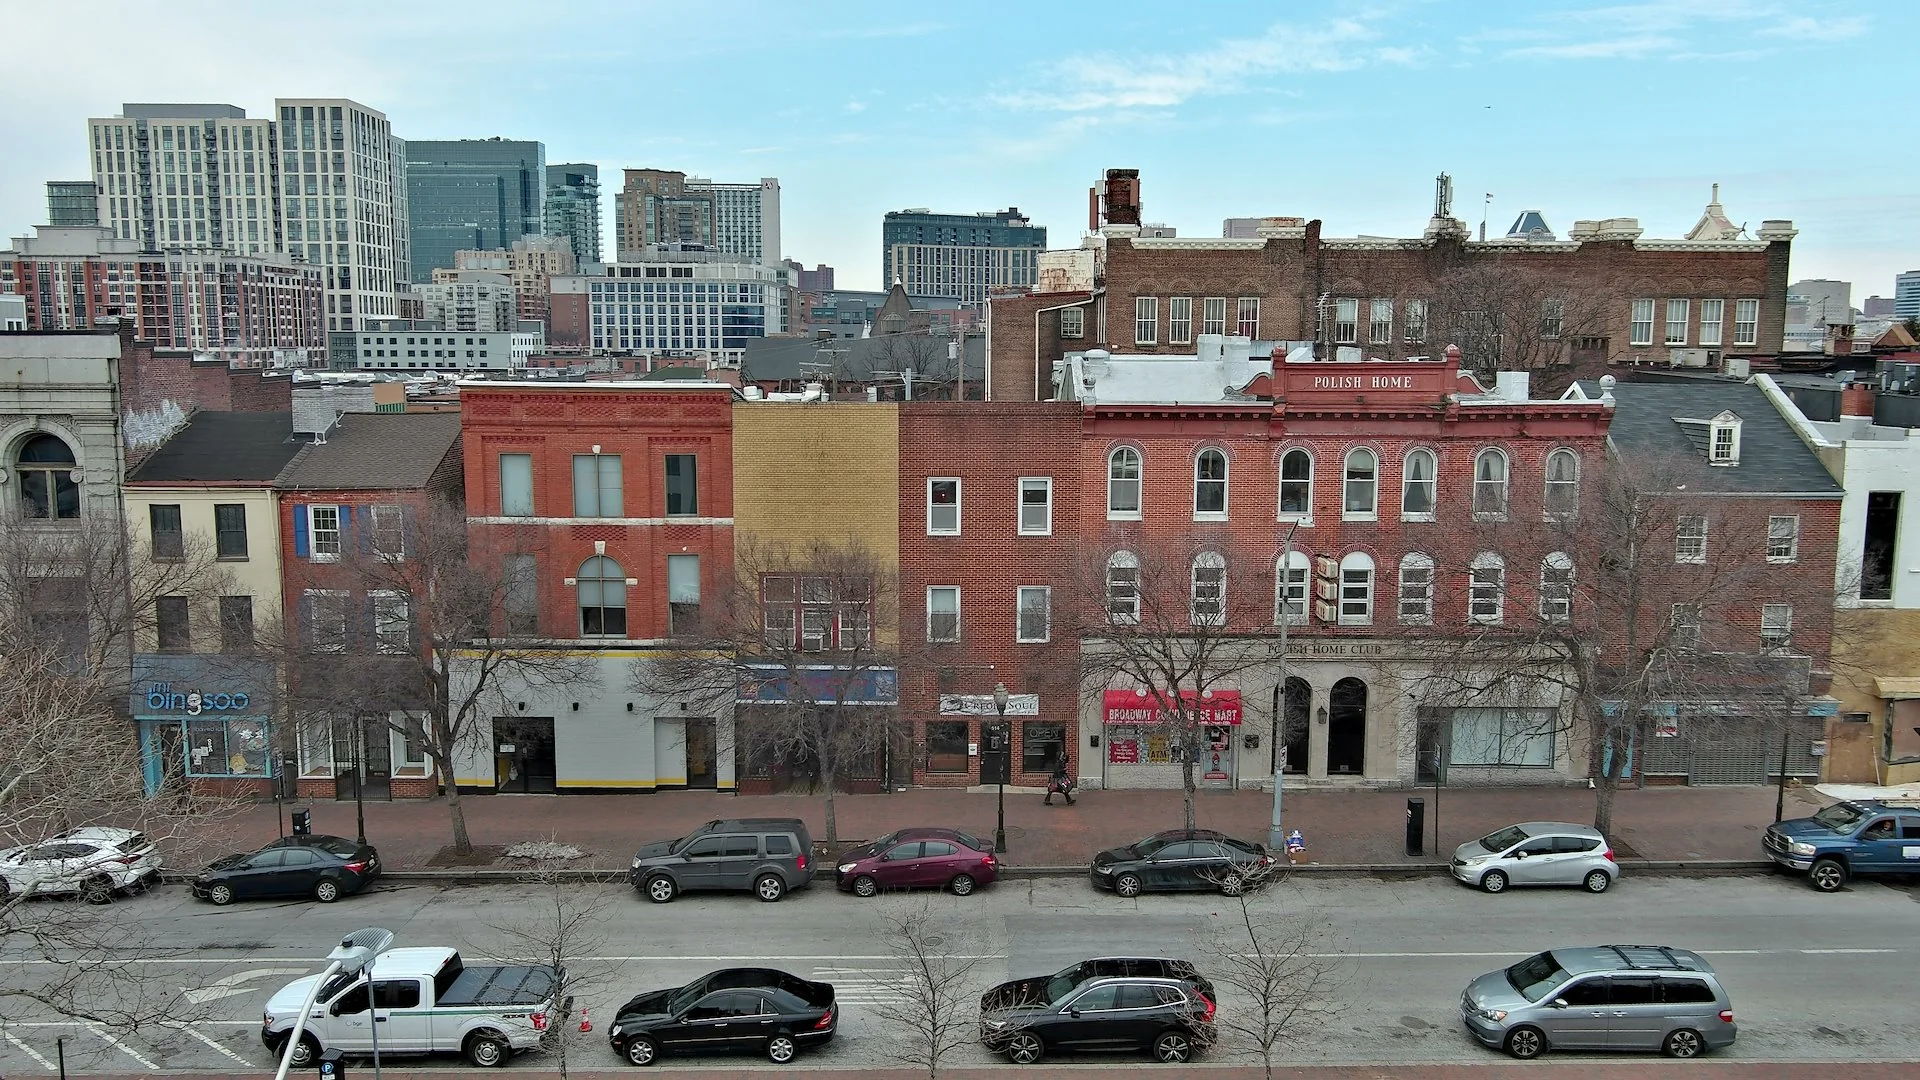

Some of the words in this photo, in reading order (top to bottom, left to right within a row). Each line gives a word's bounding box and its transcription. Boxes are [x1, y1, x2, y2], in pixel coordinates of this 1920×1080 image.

[1314, 376, 1361, 388] POLISH
[1371, 376, 1412, 388] HOME
[1313, 645, 1346, 654] HOME
[1351, 645, 1382, 654] CLUB
[148, 687, 249, 715] bingsoo
[1008, 700, 1035, 710] SOUL
[1109, 708, 1152, 720] BROADWAY
[1214, 709, 1238, 720] MART
[1150, 750, 1167, 759] ATM
